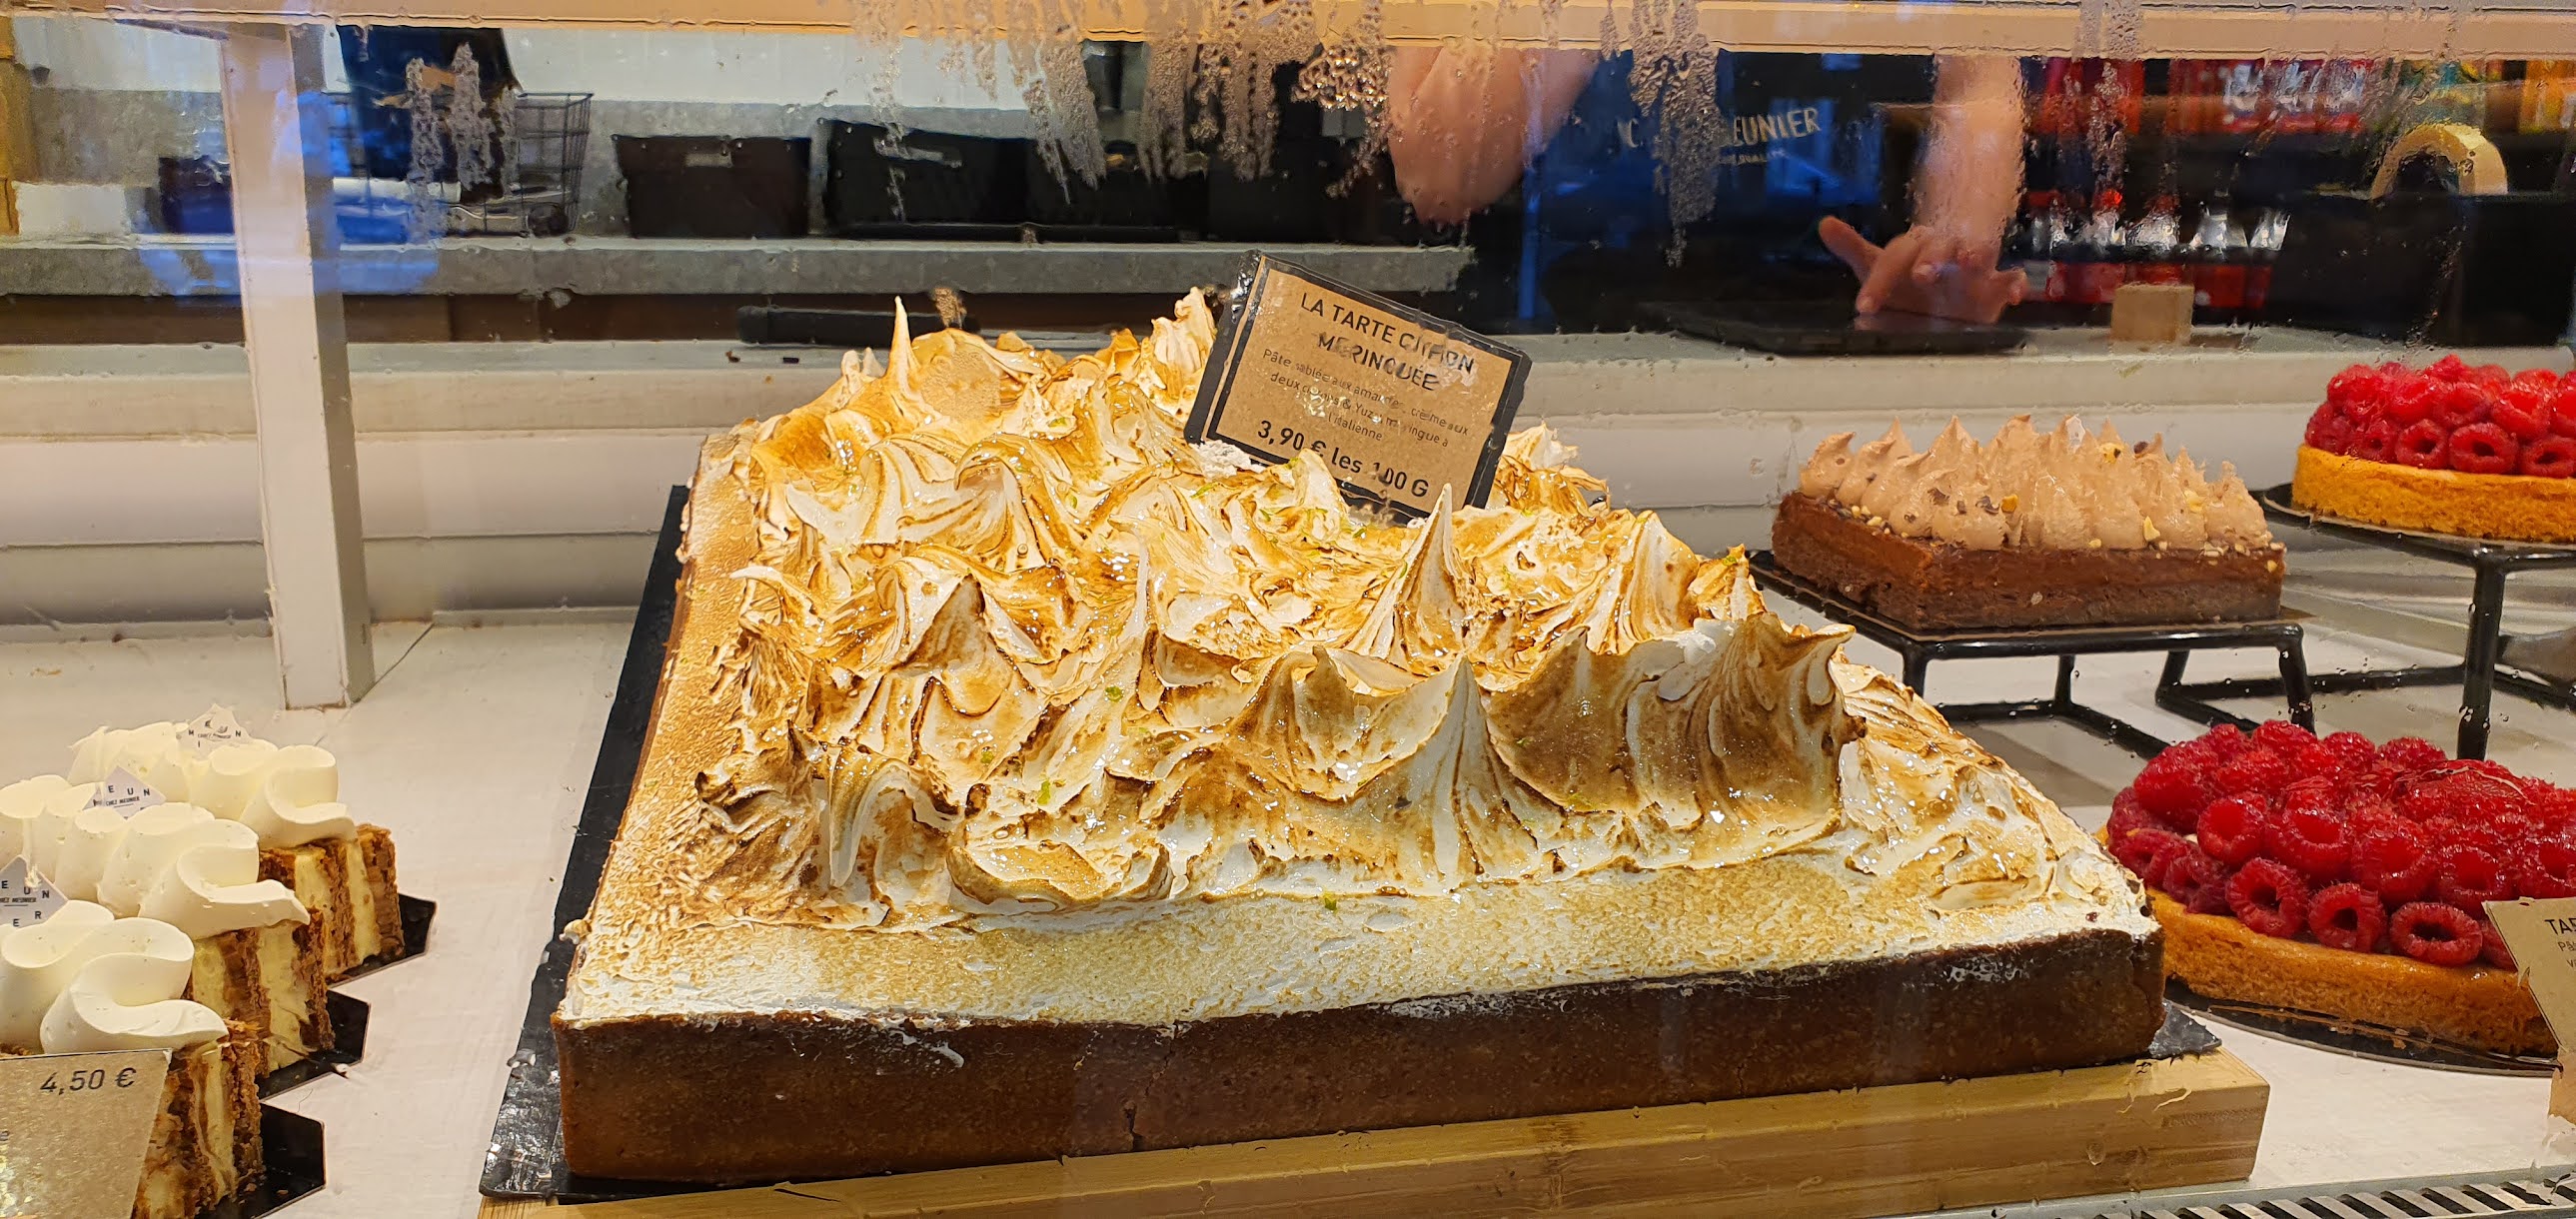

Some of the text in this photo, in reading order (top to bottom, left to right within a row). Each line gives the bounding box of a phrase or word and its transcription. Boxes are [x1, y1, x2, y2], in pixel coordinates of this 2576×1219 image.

[1301, 292, 1324, 317] LA
[1332, 304, 1396, 344] TARTE
[1263, 349, 1292, 368] Pâte
[1270, 372, 1300, 391] deux
[1342, 398, 1352, 411] &
[1385, 416, 1445, 446] mingue
[1328, 411, 1383, 442] l'italienne
[1257, 420, 1430, 498] 3,90 € les 100 G
[40, 1067, 137, 1095] 4,50 €
